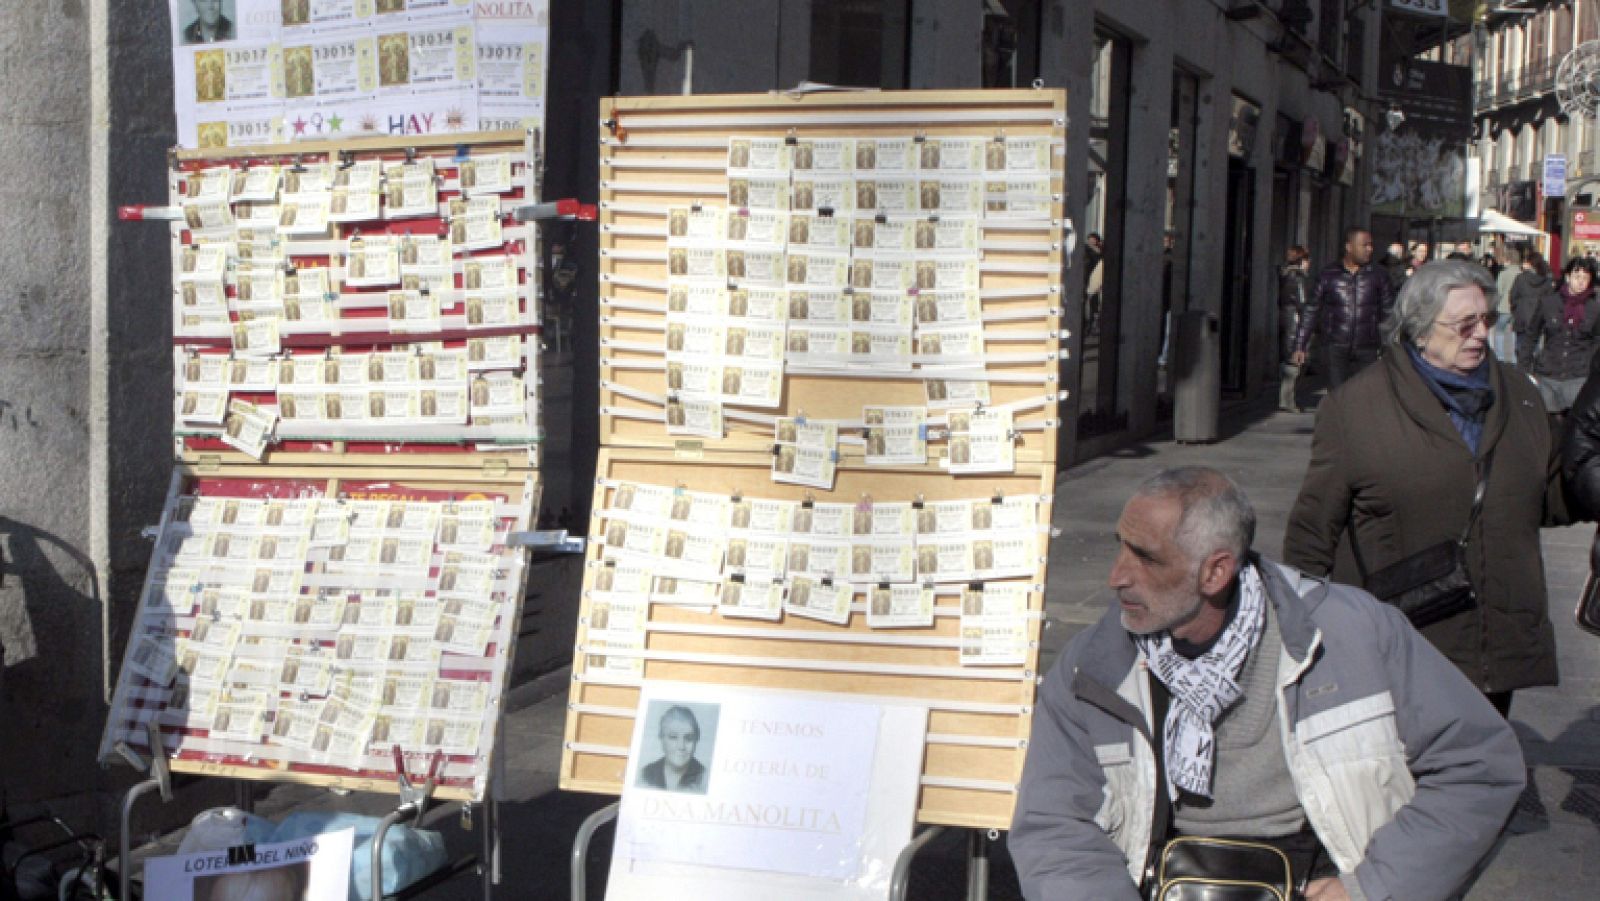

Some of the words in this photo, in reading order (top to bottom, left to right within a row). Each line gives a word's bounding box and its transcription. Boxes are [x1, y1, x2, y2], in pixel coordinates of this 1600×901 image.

[410, 32, 453, 47] 13014
[227, 48, 268, 64] 13017
[314, 43, 356, 60] 13015
[478, 45, 522, 60] 13017
[229, 120, 271, 137] 13015
[388, 112, 434, 135] HAY
[740, 719, 825, 738] TENEMOS
[723, 758, 800, 778] LOTERÍA
[805, 763, 830, 780] DE
[703, 801, 844, 831] MANOLITA
